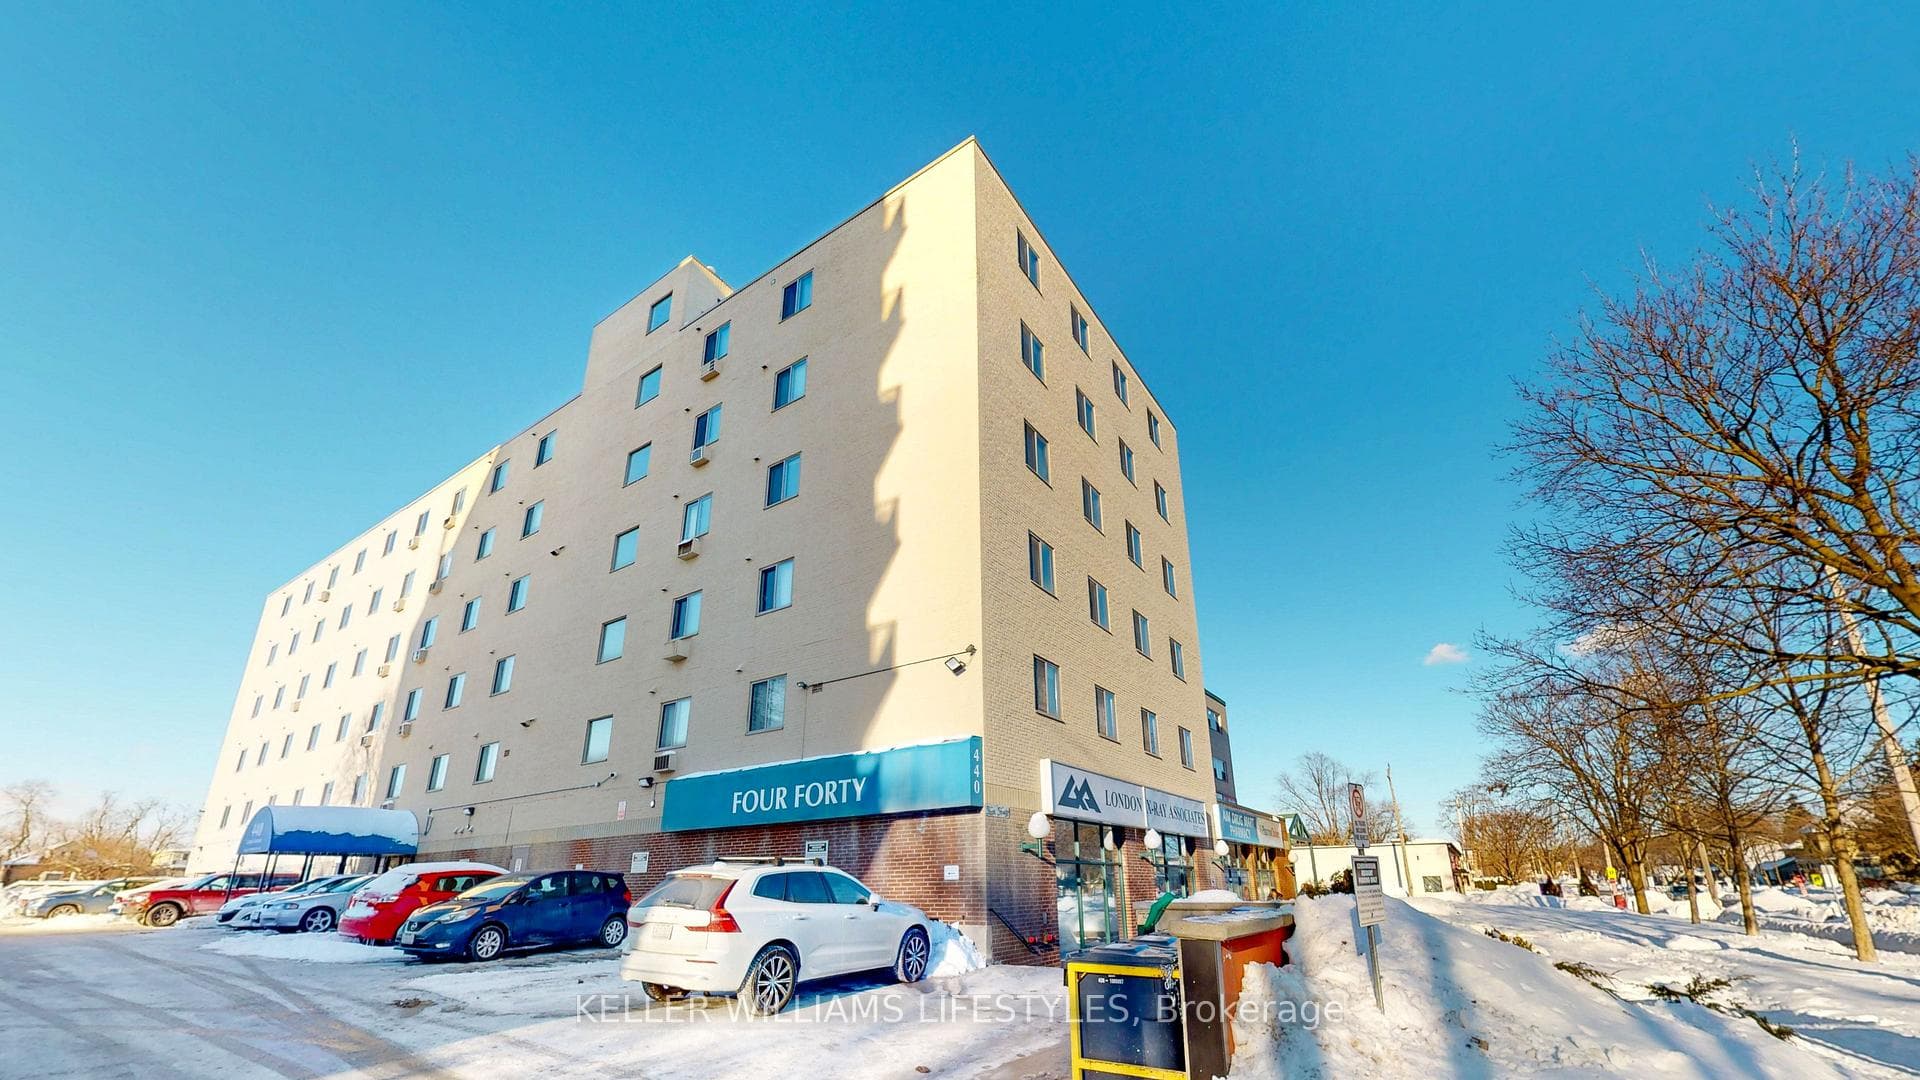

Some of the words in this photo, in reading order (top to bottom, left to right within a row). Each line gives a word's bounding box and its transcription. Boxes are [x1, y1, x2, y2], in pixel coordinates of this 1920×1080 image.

[973, 748, 981, 794] 440
[732, 787, 787, 814] FOUR
[794, 777, 867, 808] FORTY
[1105, 789, 1143, 812] LONDON
[1168, 805, 1206, 825] ASSOCIATES
